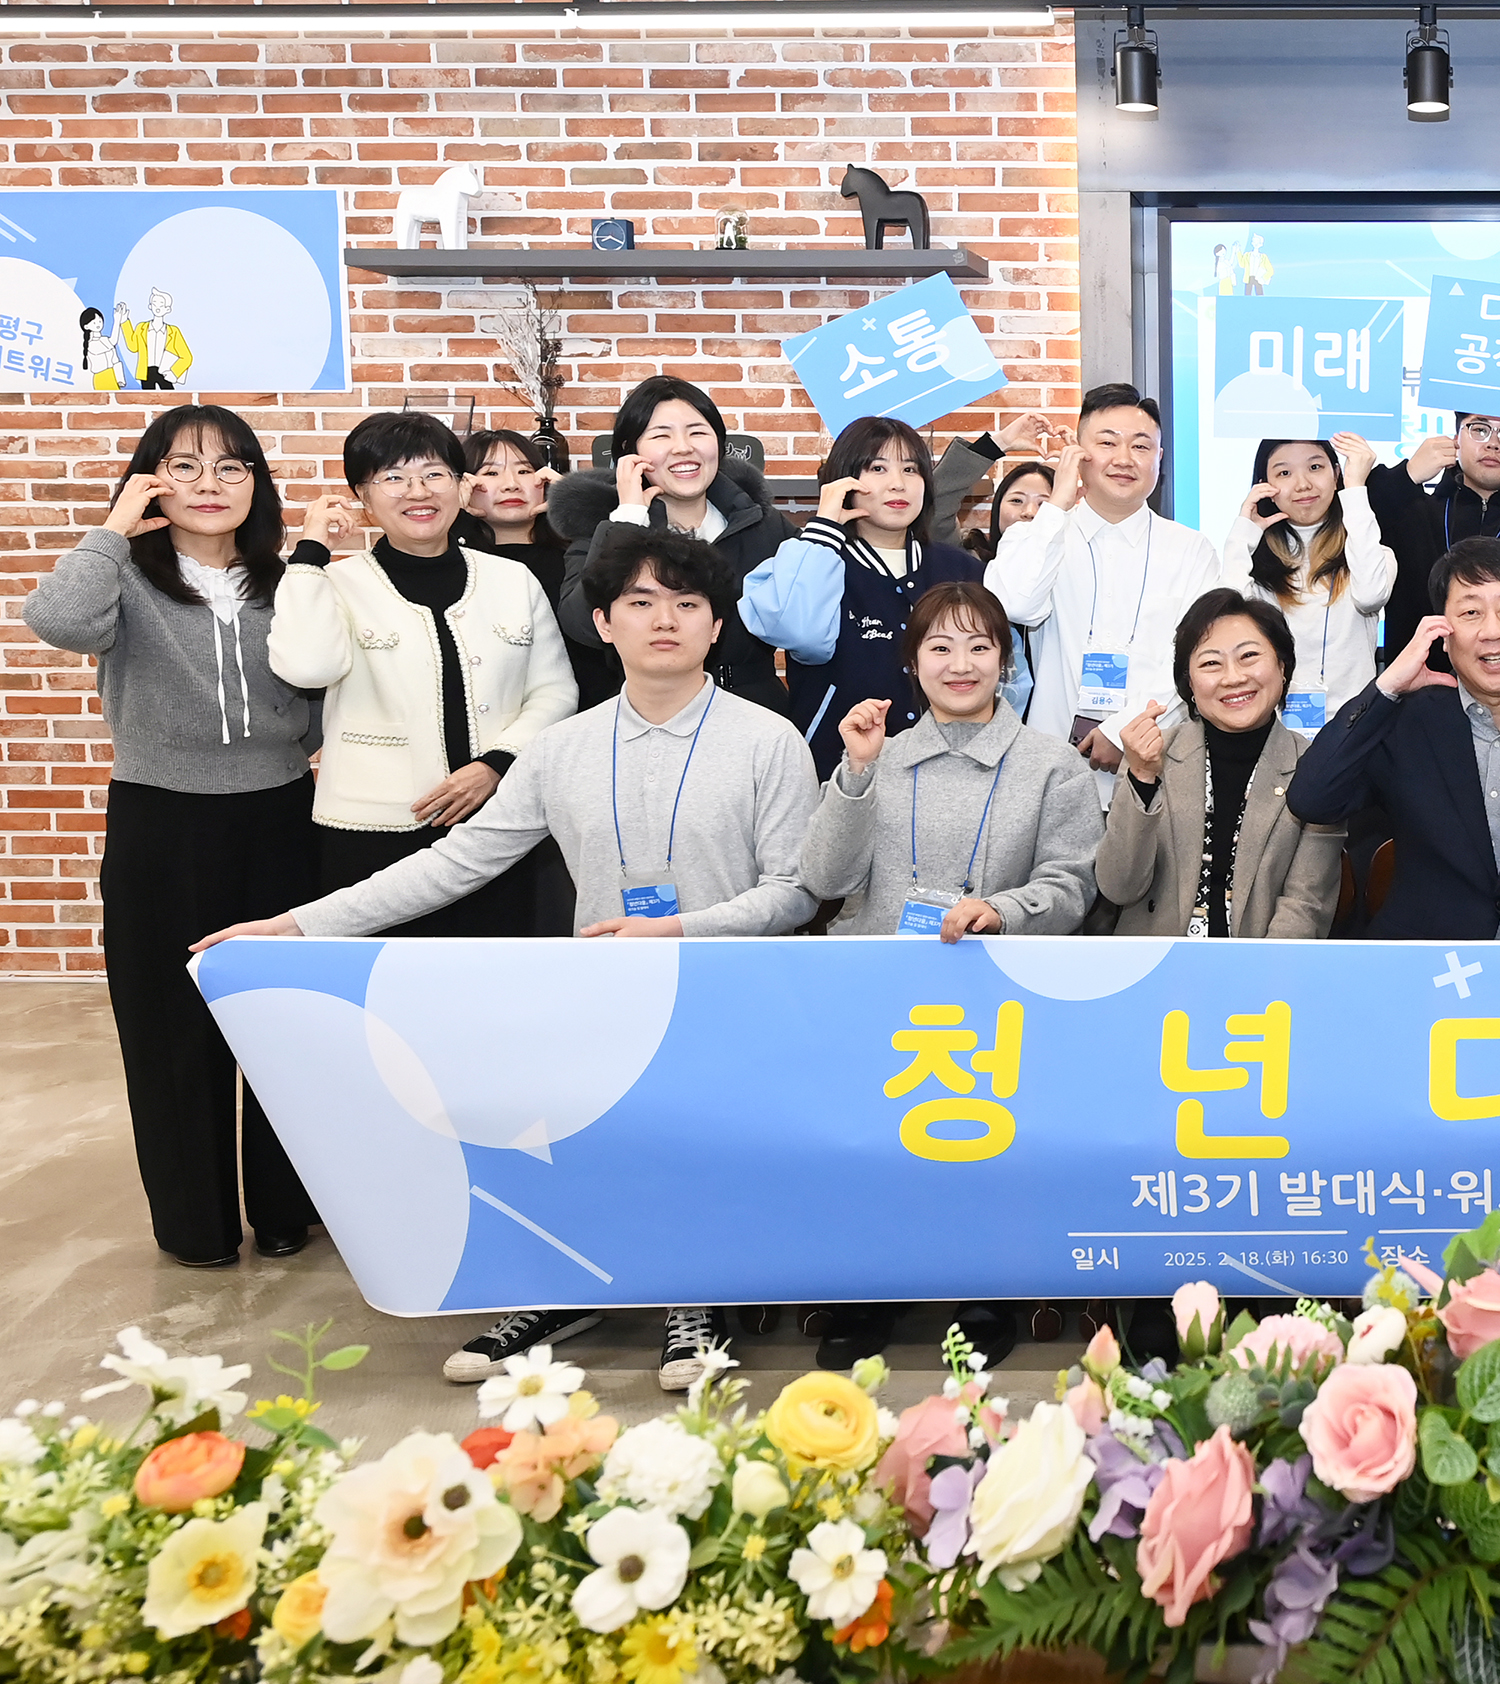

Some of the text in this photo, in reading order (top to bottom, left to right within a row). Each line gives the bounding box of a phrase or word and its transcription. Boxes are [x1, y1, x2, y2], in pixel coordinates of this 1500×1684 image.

[0, 345, 76, 386] 트워크
[839, 308, 950, 400] 소통
[1250, 324, 1371, 394] 미래
[1131, 1169, 1259, 1217] 제3기
[1071, 1247, 1119, 1270] 일시
[1164, 1252, 1211, 1267] 2025.
[1302, 1250, 1349, 1265] 16:30
[1381, 1244, 1430, 1268] 장소
